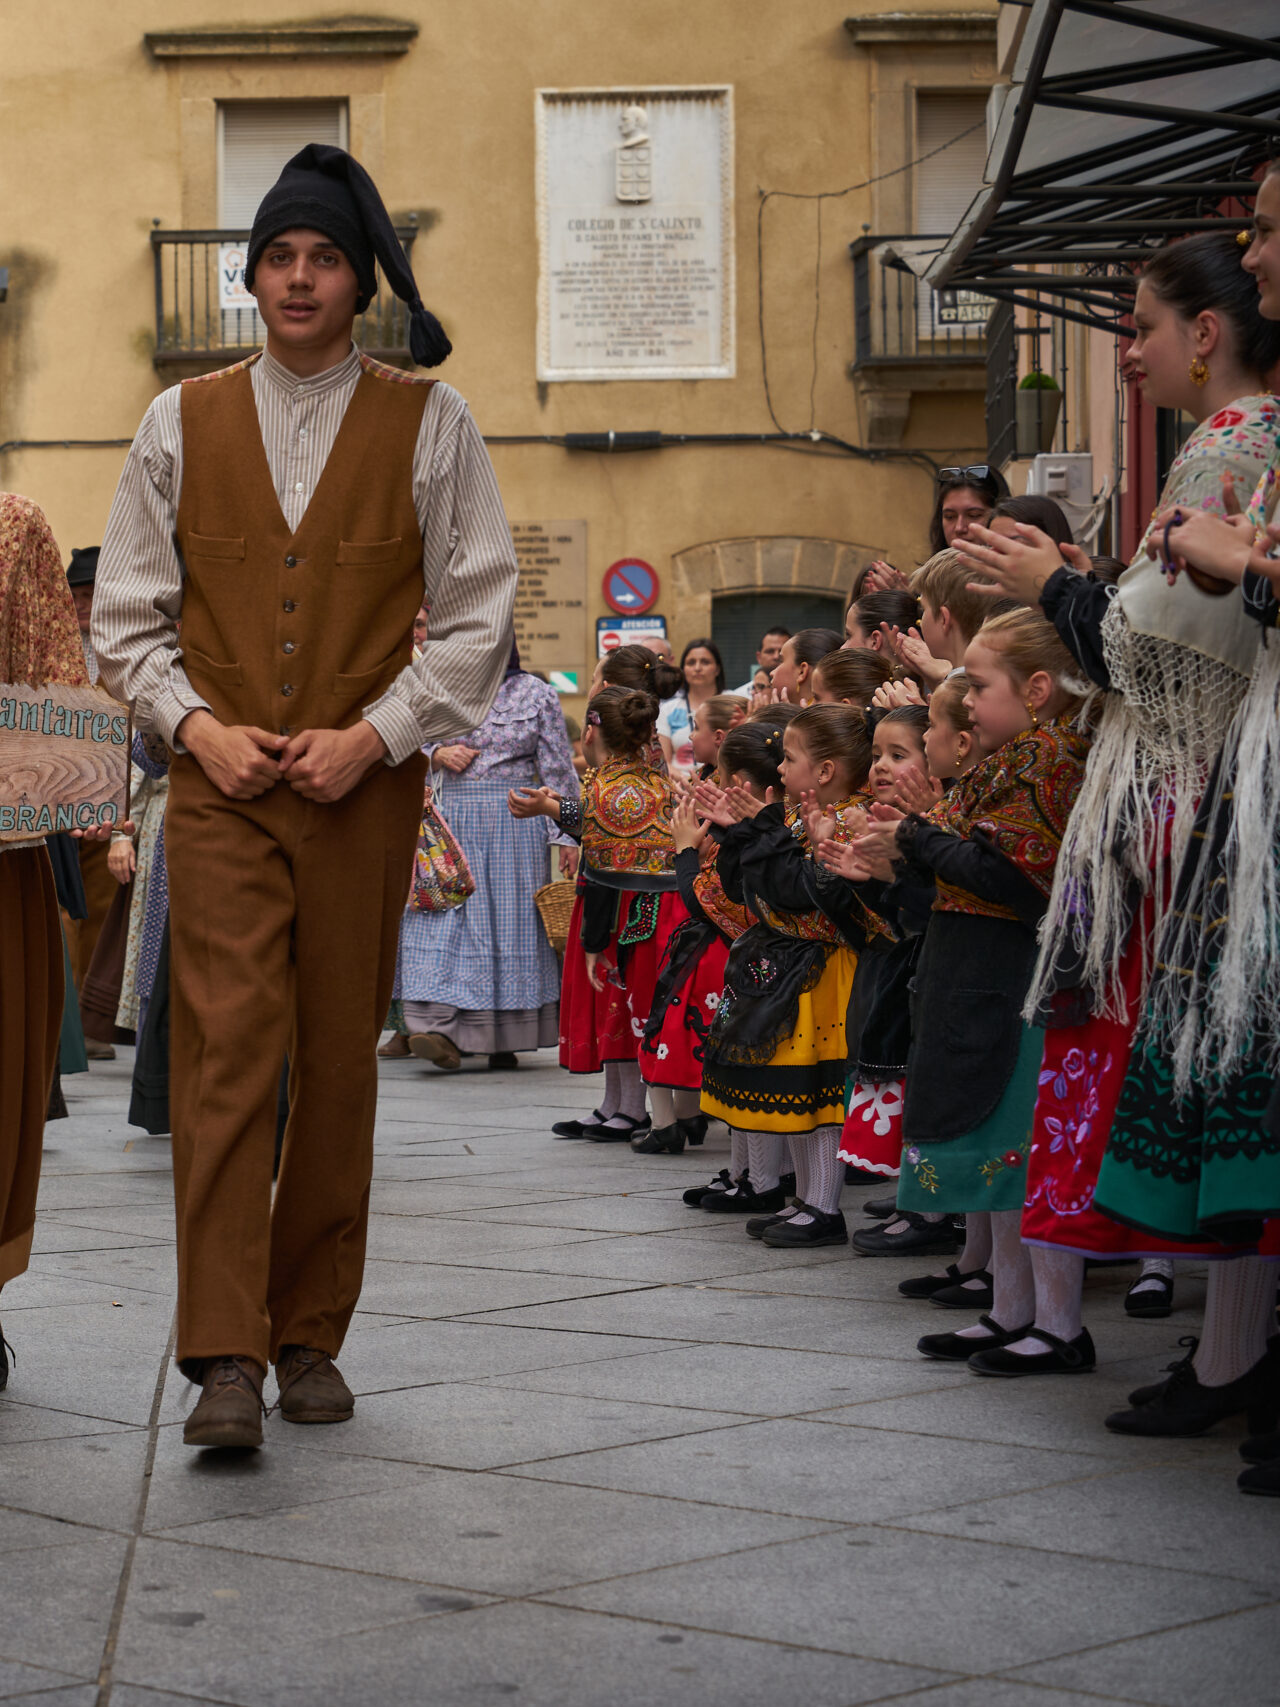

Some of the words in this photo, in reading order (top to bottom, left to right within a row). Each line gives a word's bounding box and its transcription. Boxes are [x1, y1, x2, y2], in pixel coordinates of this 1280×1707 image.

[568, 217, 615, 231] COLEGIO
[620, 217, 634, 230] DE
[651, 217, 702, 230] CALIXTO
[622, 619, 660, 629] ATENCIÓN
